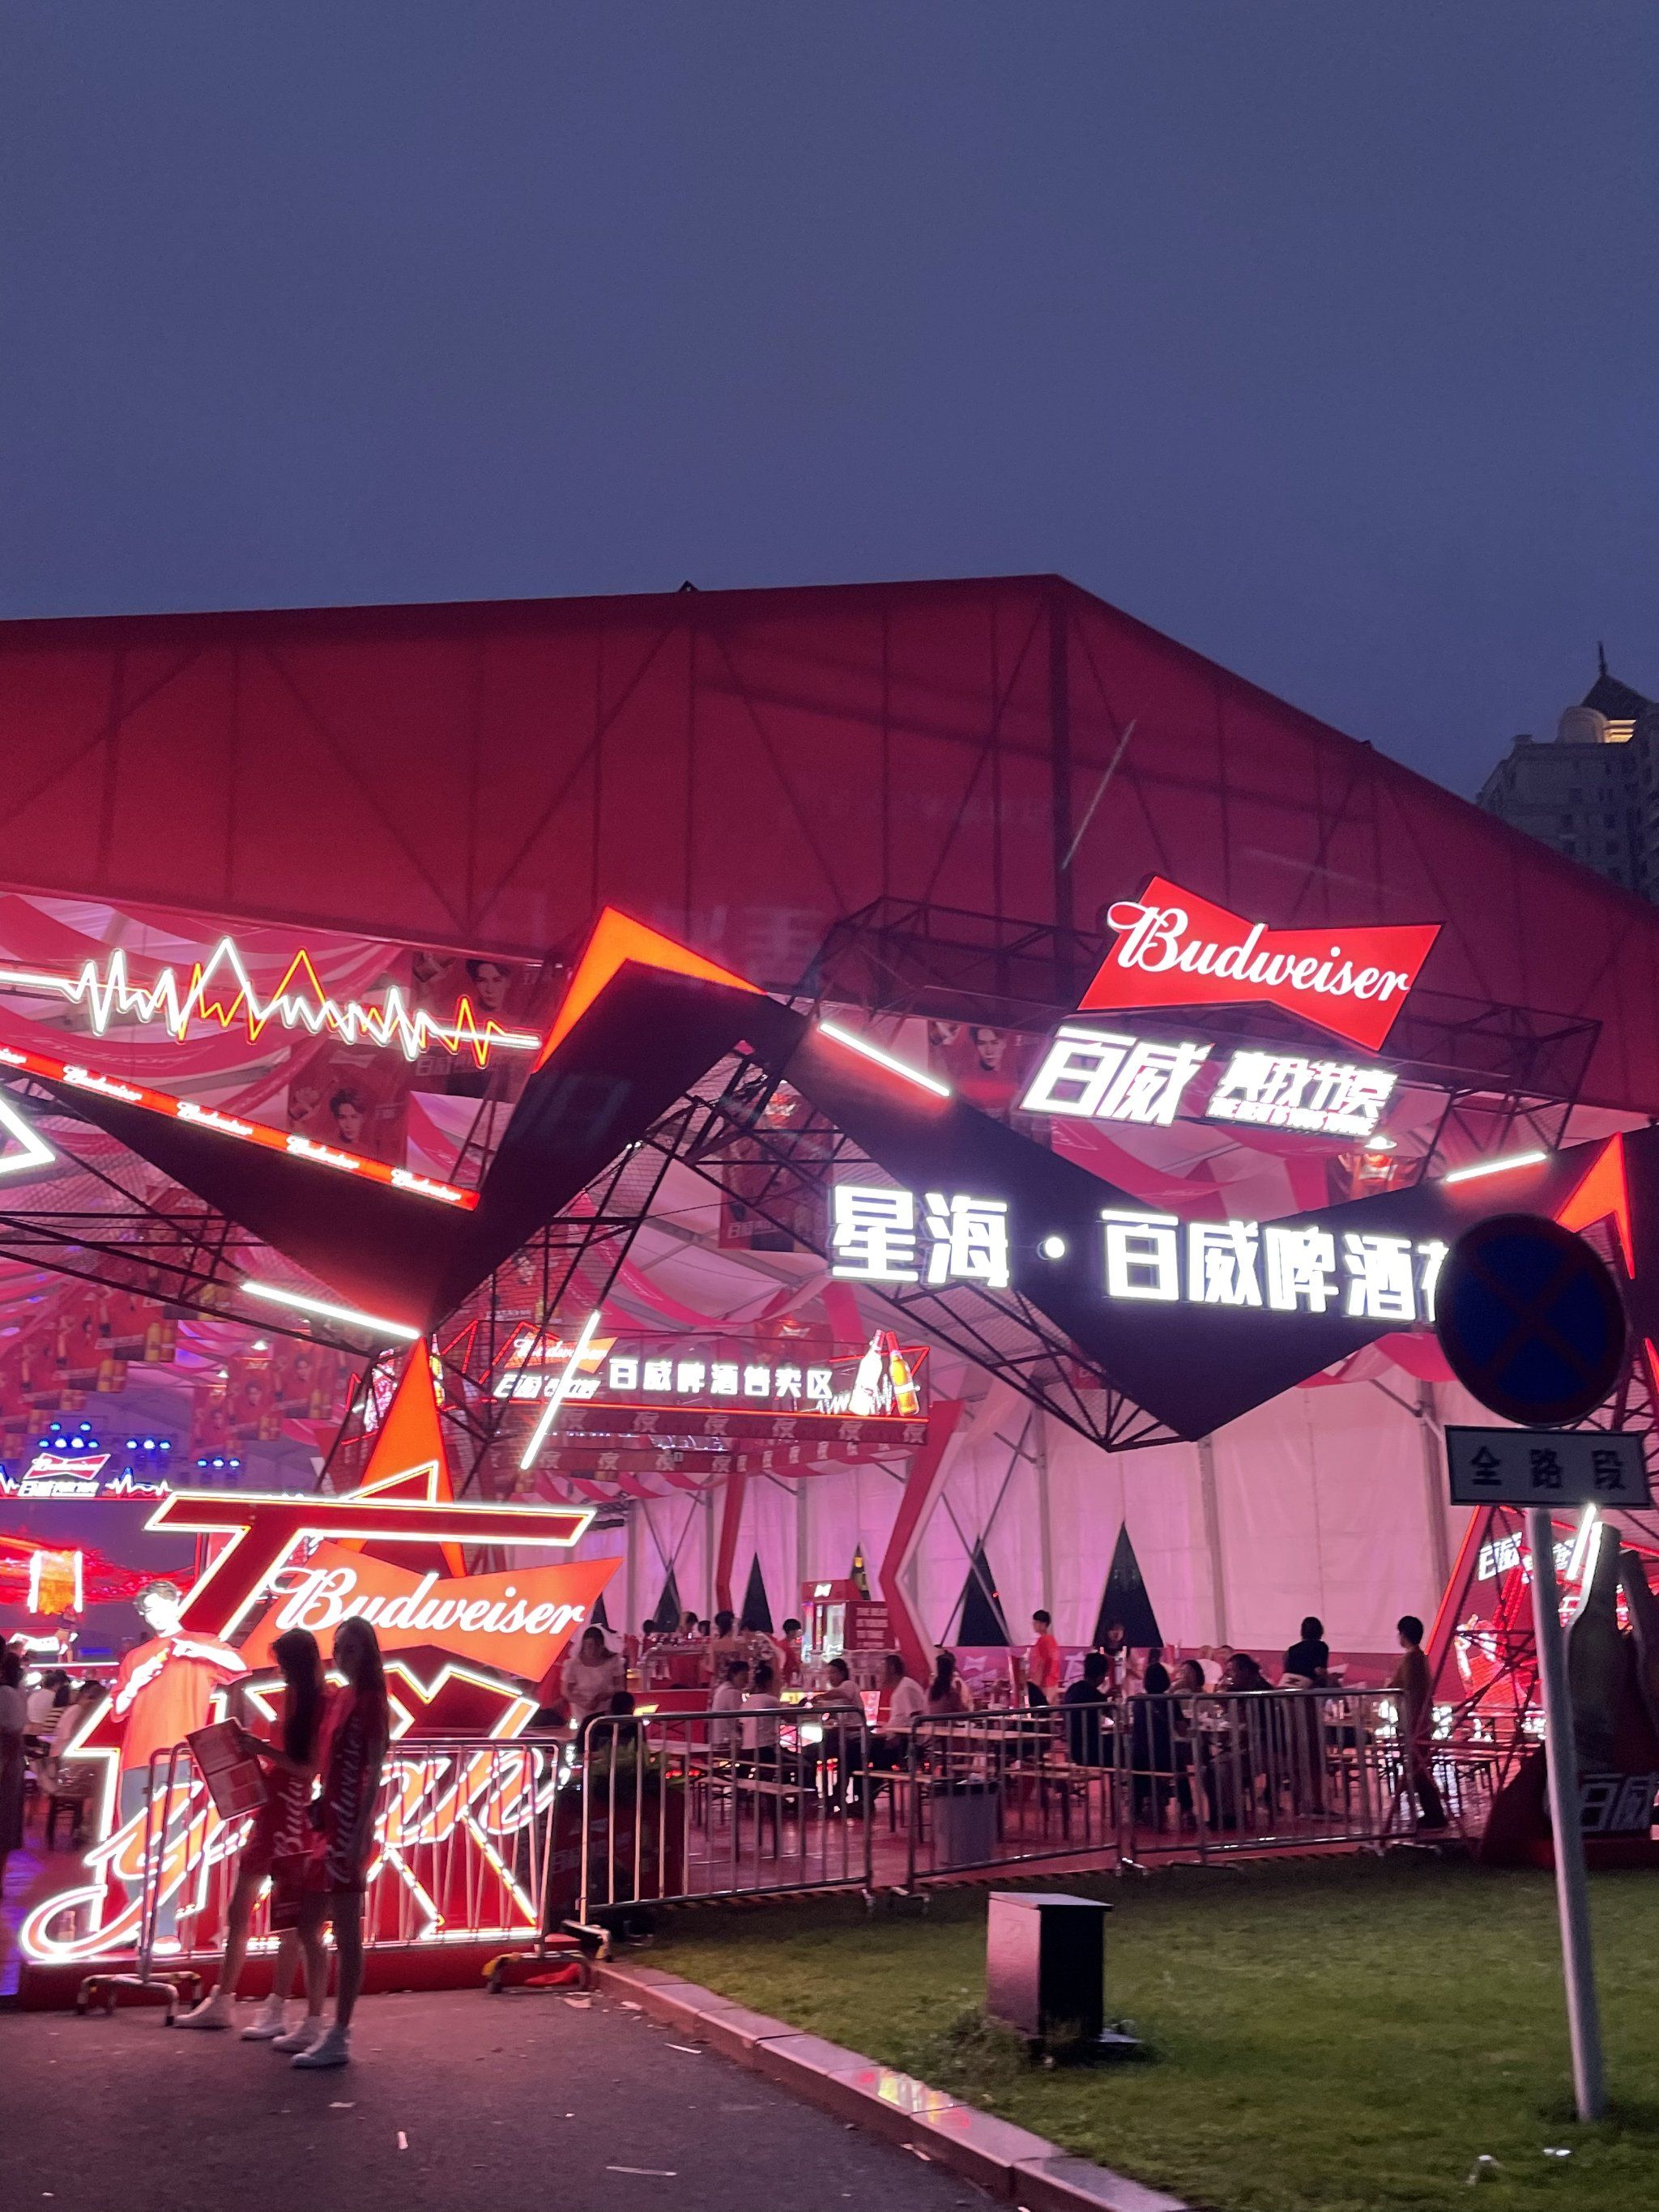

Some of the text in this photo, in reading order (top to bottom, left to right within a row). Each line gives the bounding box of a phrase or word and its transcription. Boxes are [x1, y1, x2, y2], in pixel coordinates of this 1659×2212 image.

[1107, 901, 1411, 1002] Budweiser
[1020, 1026, 1215, 1127] 百威
[1471, 1446, 1626, 1490] 全路段
[271, 1566, 586, 1635] Budweiser
